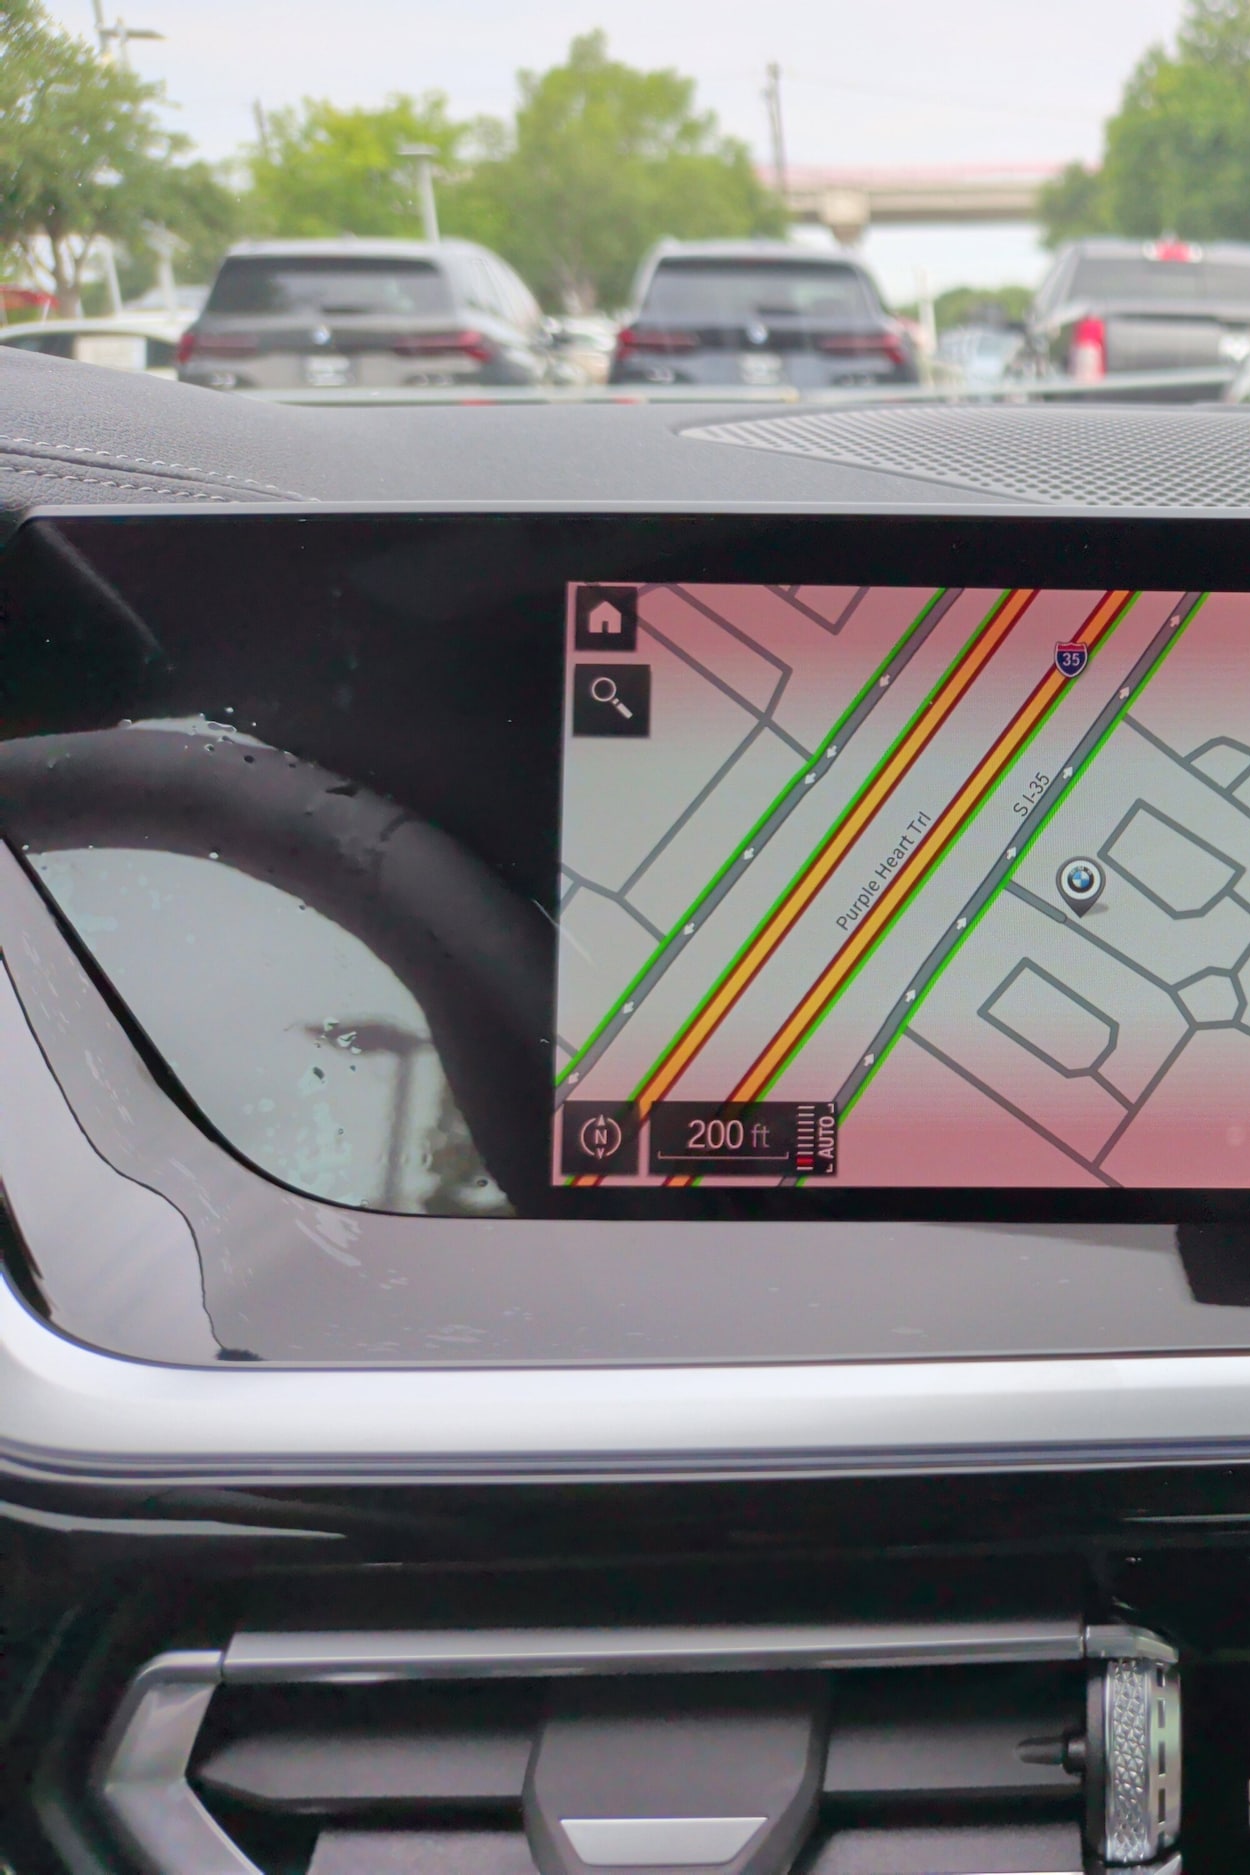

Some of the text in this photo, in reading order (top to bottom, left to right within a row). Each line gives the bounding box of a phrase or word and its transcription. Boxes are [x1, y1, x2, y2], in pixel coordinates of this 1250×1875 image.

[1062, 652, 1081, 667] 35
[1012, 801, 1029, 818] S
[835, 811, 932, 931] Purple Heart Trl
[688, 1118, 771, 1149] 200 ft
[818, 1116, 835, 1159] AUTO
